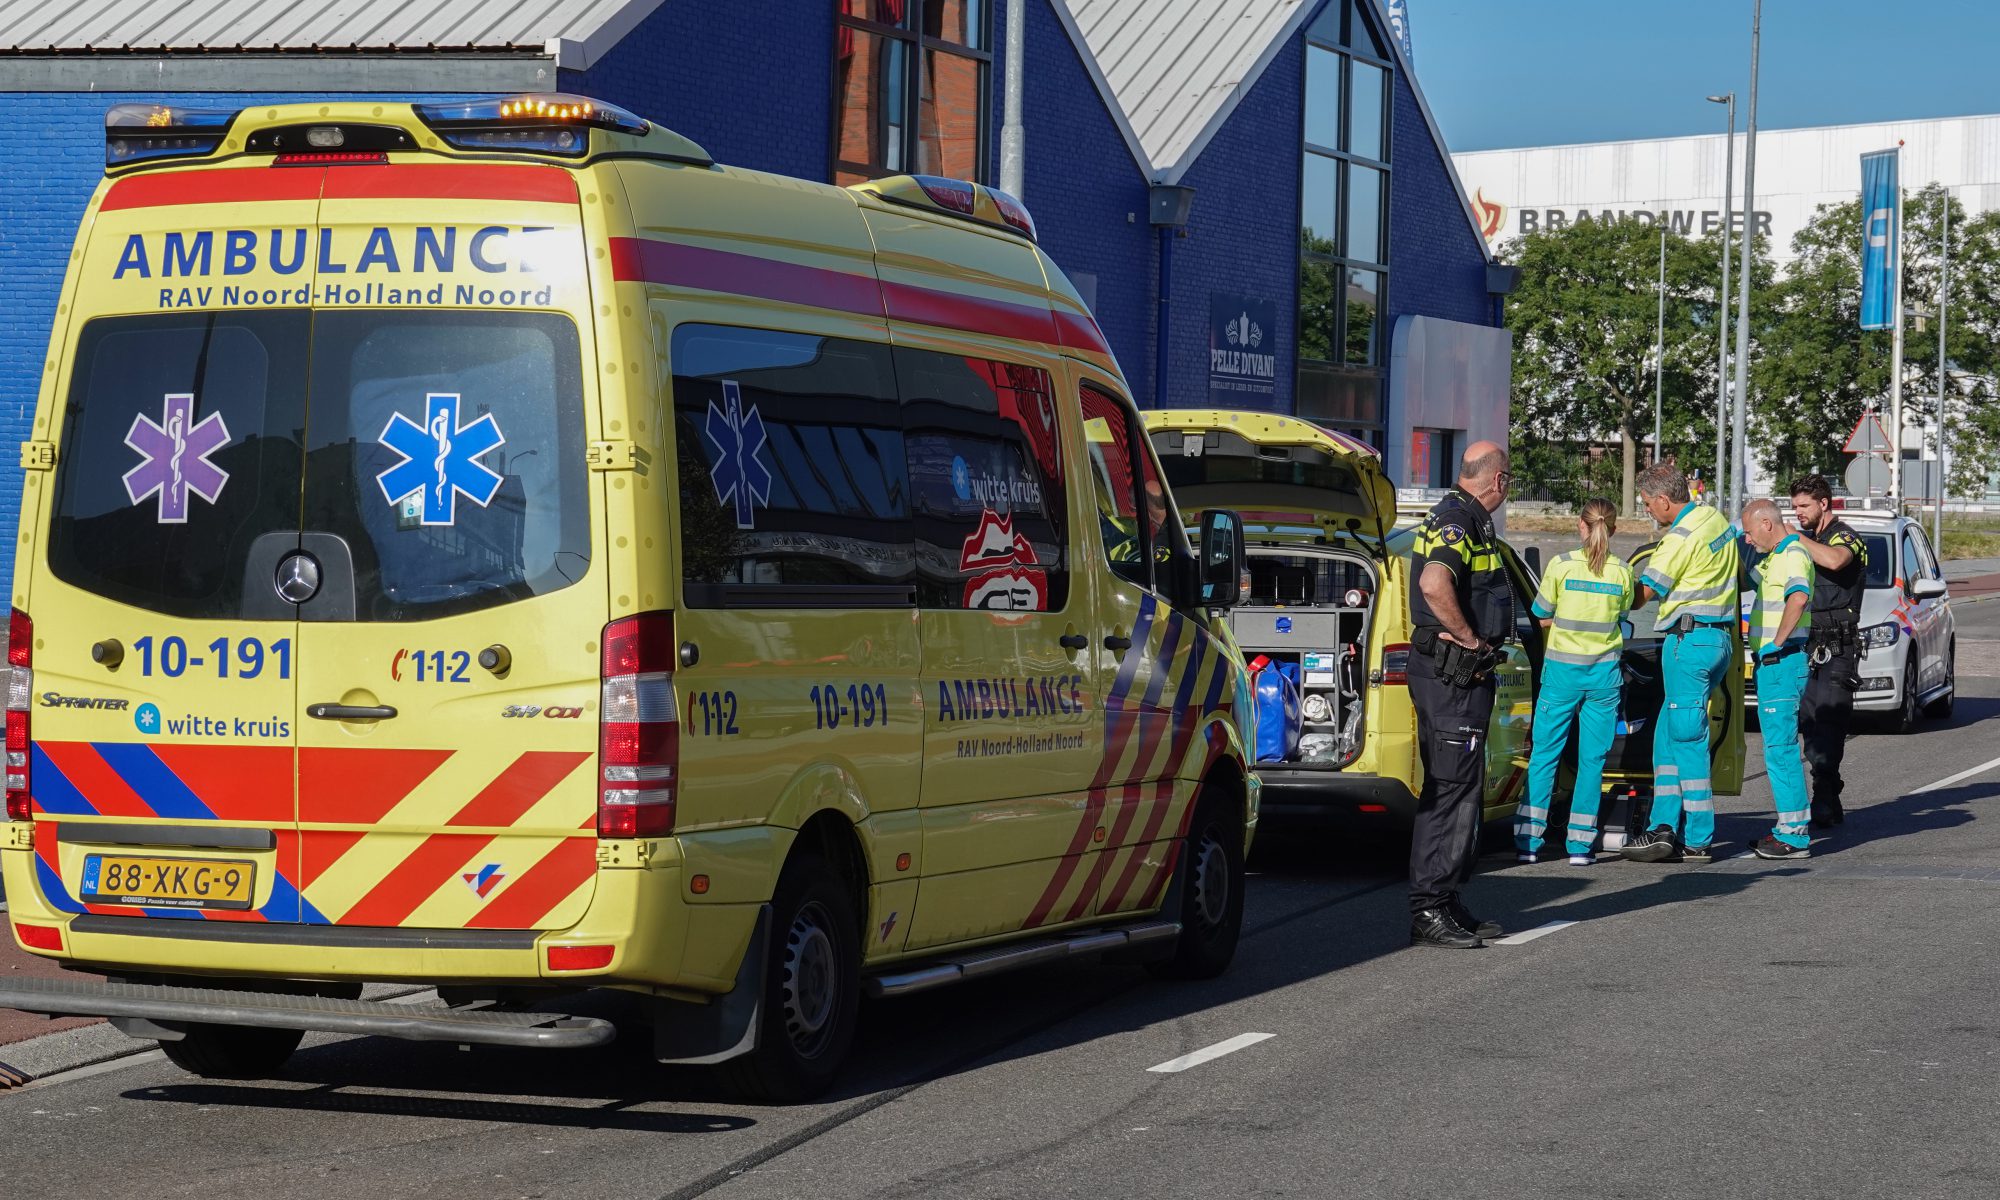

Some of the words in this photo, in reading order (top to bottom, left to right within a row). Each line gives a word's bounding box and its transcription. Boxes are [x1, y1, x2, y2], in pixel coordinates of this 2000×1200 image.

[112, 226, 554, 279] AMBULANC
[159, 286, 213, 308] RAV
[222, 283, 444, 305] Noord-Holland
[455, 284, 552, 305] Noord
[1211, 349, 1240, 374] PELLE
[1241, 352, 1275, 377] DIVANI
[972, 472, 1008, 503] witte
[1009, 475, 1041, 504] kruis
[134, 636, 291, 679] 10-191
[501, 705, 542, 719] 319
[543, 706, 584, 719] CDI
[810, 683, 888, 729] 10-191
[939, 675, 1083, 722] AMBULANCE
[168, 714, 227, 736] witte
[234, 716, 290, 737] kruis
[958, 739, 979, 758] RAV
[982, 733, 1053, 756] Noord-Holland
[1056, 731, 1083, 749] Noord
[85, 880, 97, 889] NL
[106, 863, 241, 896] 88-XKG-9
